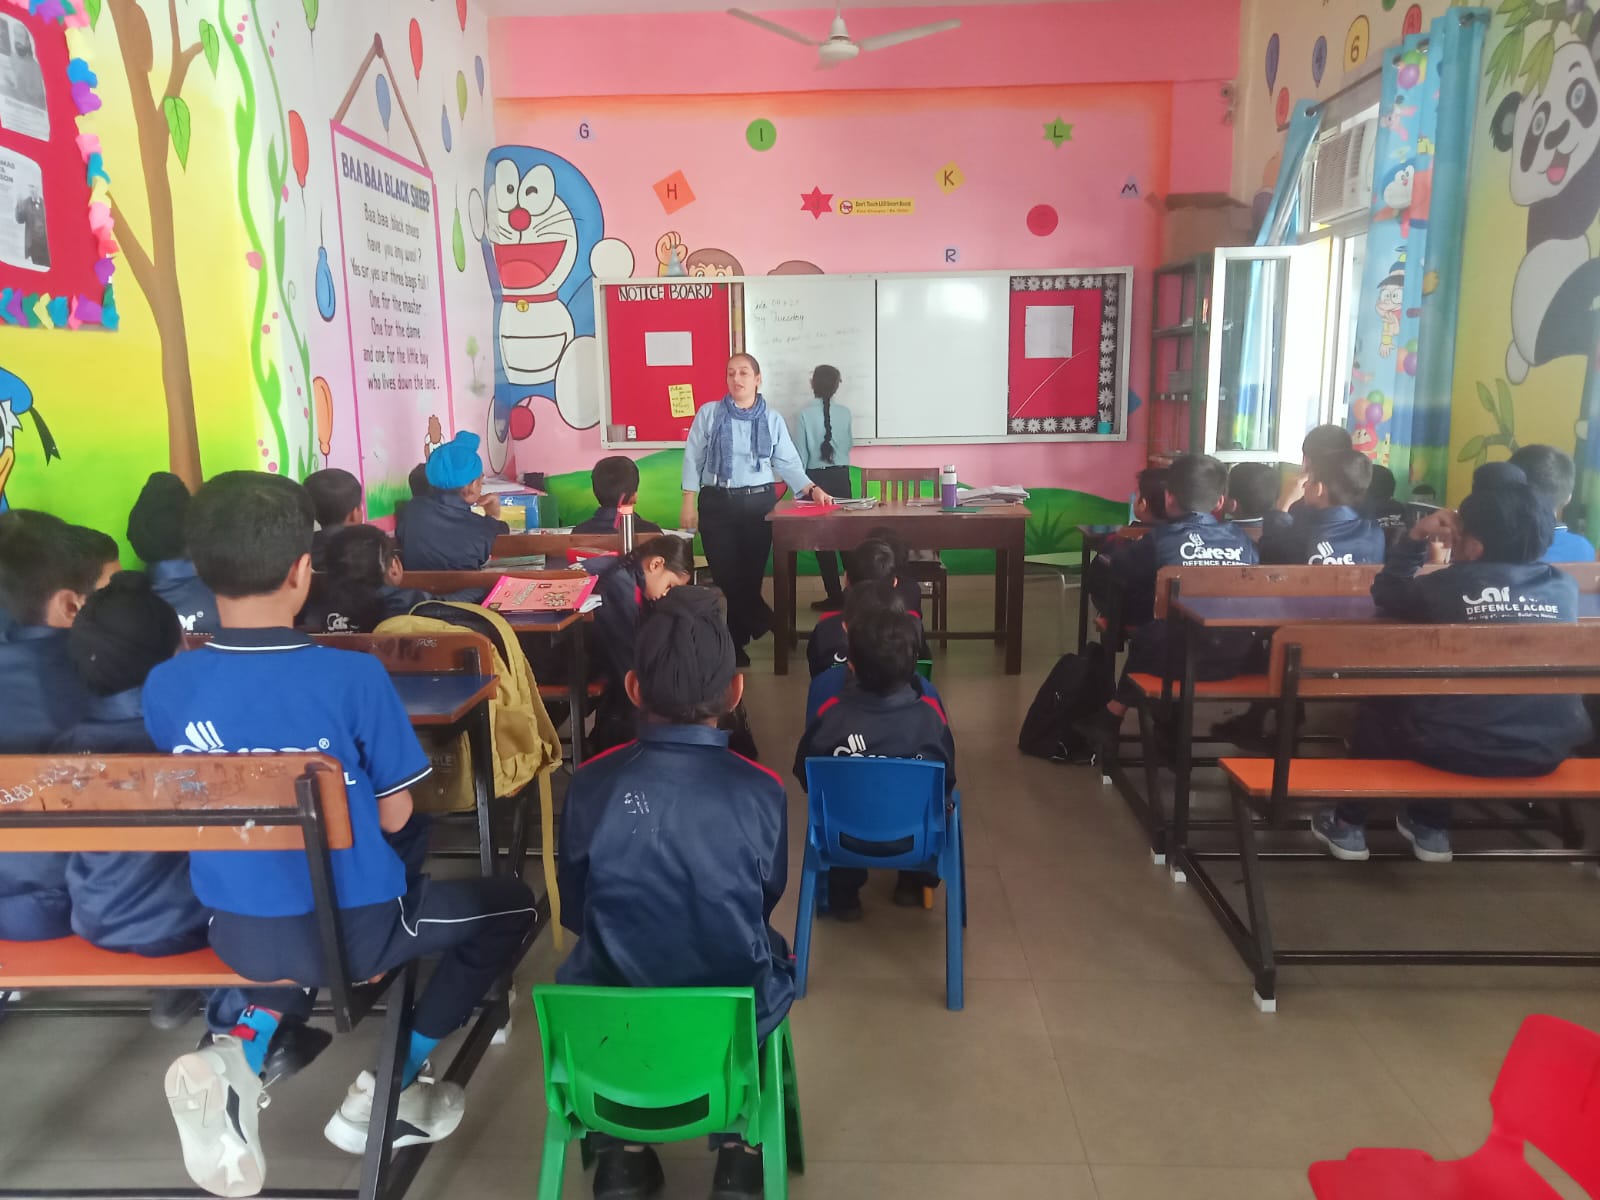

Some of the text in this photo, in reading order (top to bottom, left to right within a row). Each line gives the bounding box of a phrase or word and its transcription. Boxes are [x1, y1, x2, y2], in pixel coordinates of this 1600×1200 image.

[1350, 35, 1360, 62] 6
[579, 123, 590, 139] G
[1053, 124, 1064, 138] L
[341, 151, 430, 213] BAA BAA BLACK SHEEP
[944, 170, 954, 186] K
[666, 183, 678, 200] H
[1121, 183, 1138, 194] M
[945, 248, 957, 262] R
[369, 289, 380, 309] One
[619, 283, 712, 301] NOTICE BOARD
[371, 316, 383, 336] One
[368, 372, 380, 390] who
[382, 373, 396, 390] lives
[398, 373, 412, 390] down
[414, 374, 423, 390] the
[1466, 604, 1520, 615] DEFENCE
